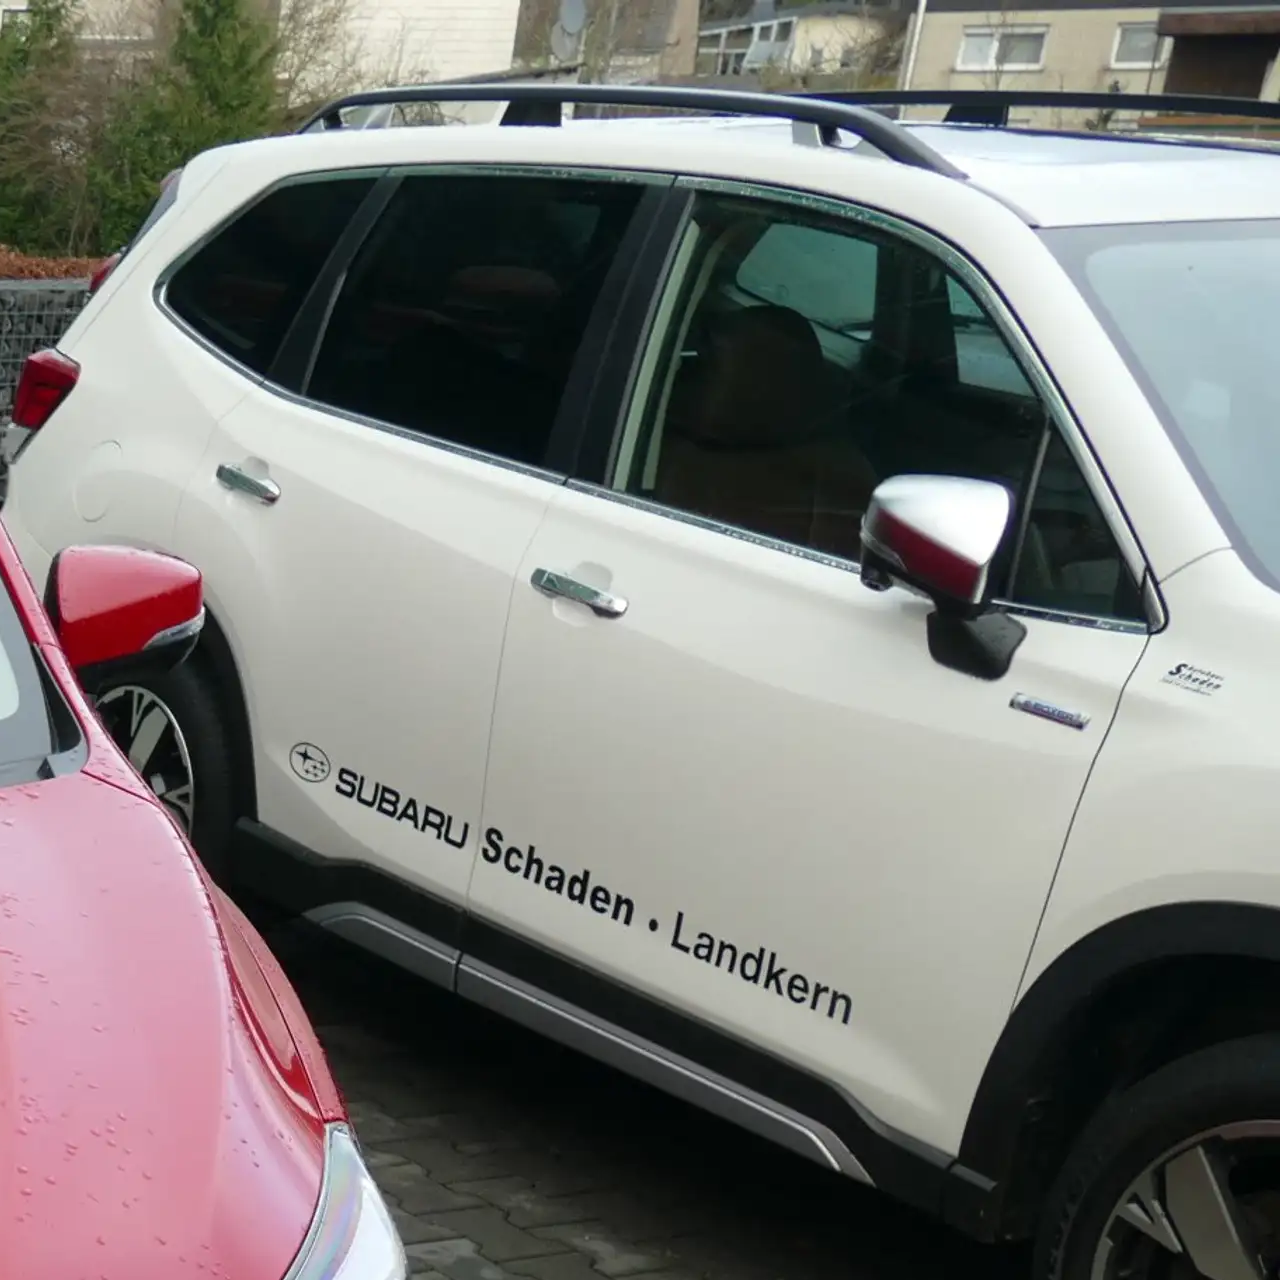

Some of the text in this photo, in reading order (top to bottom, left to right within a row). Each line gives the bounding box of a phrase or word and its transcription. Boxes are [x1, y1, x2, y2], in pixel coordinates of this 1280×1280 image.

[335, 767, 854, 1026] SUBARU Schaden Landkern
